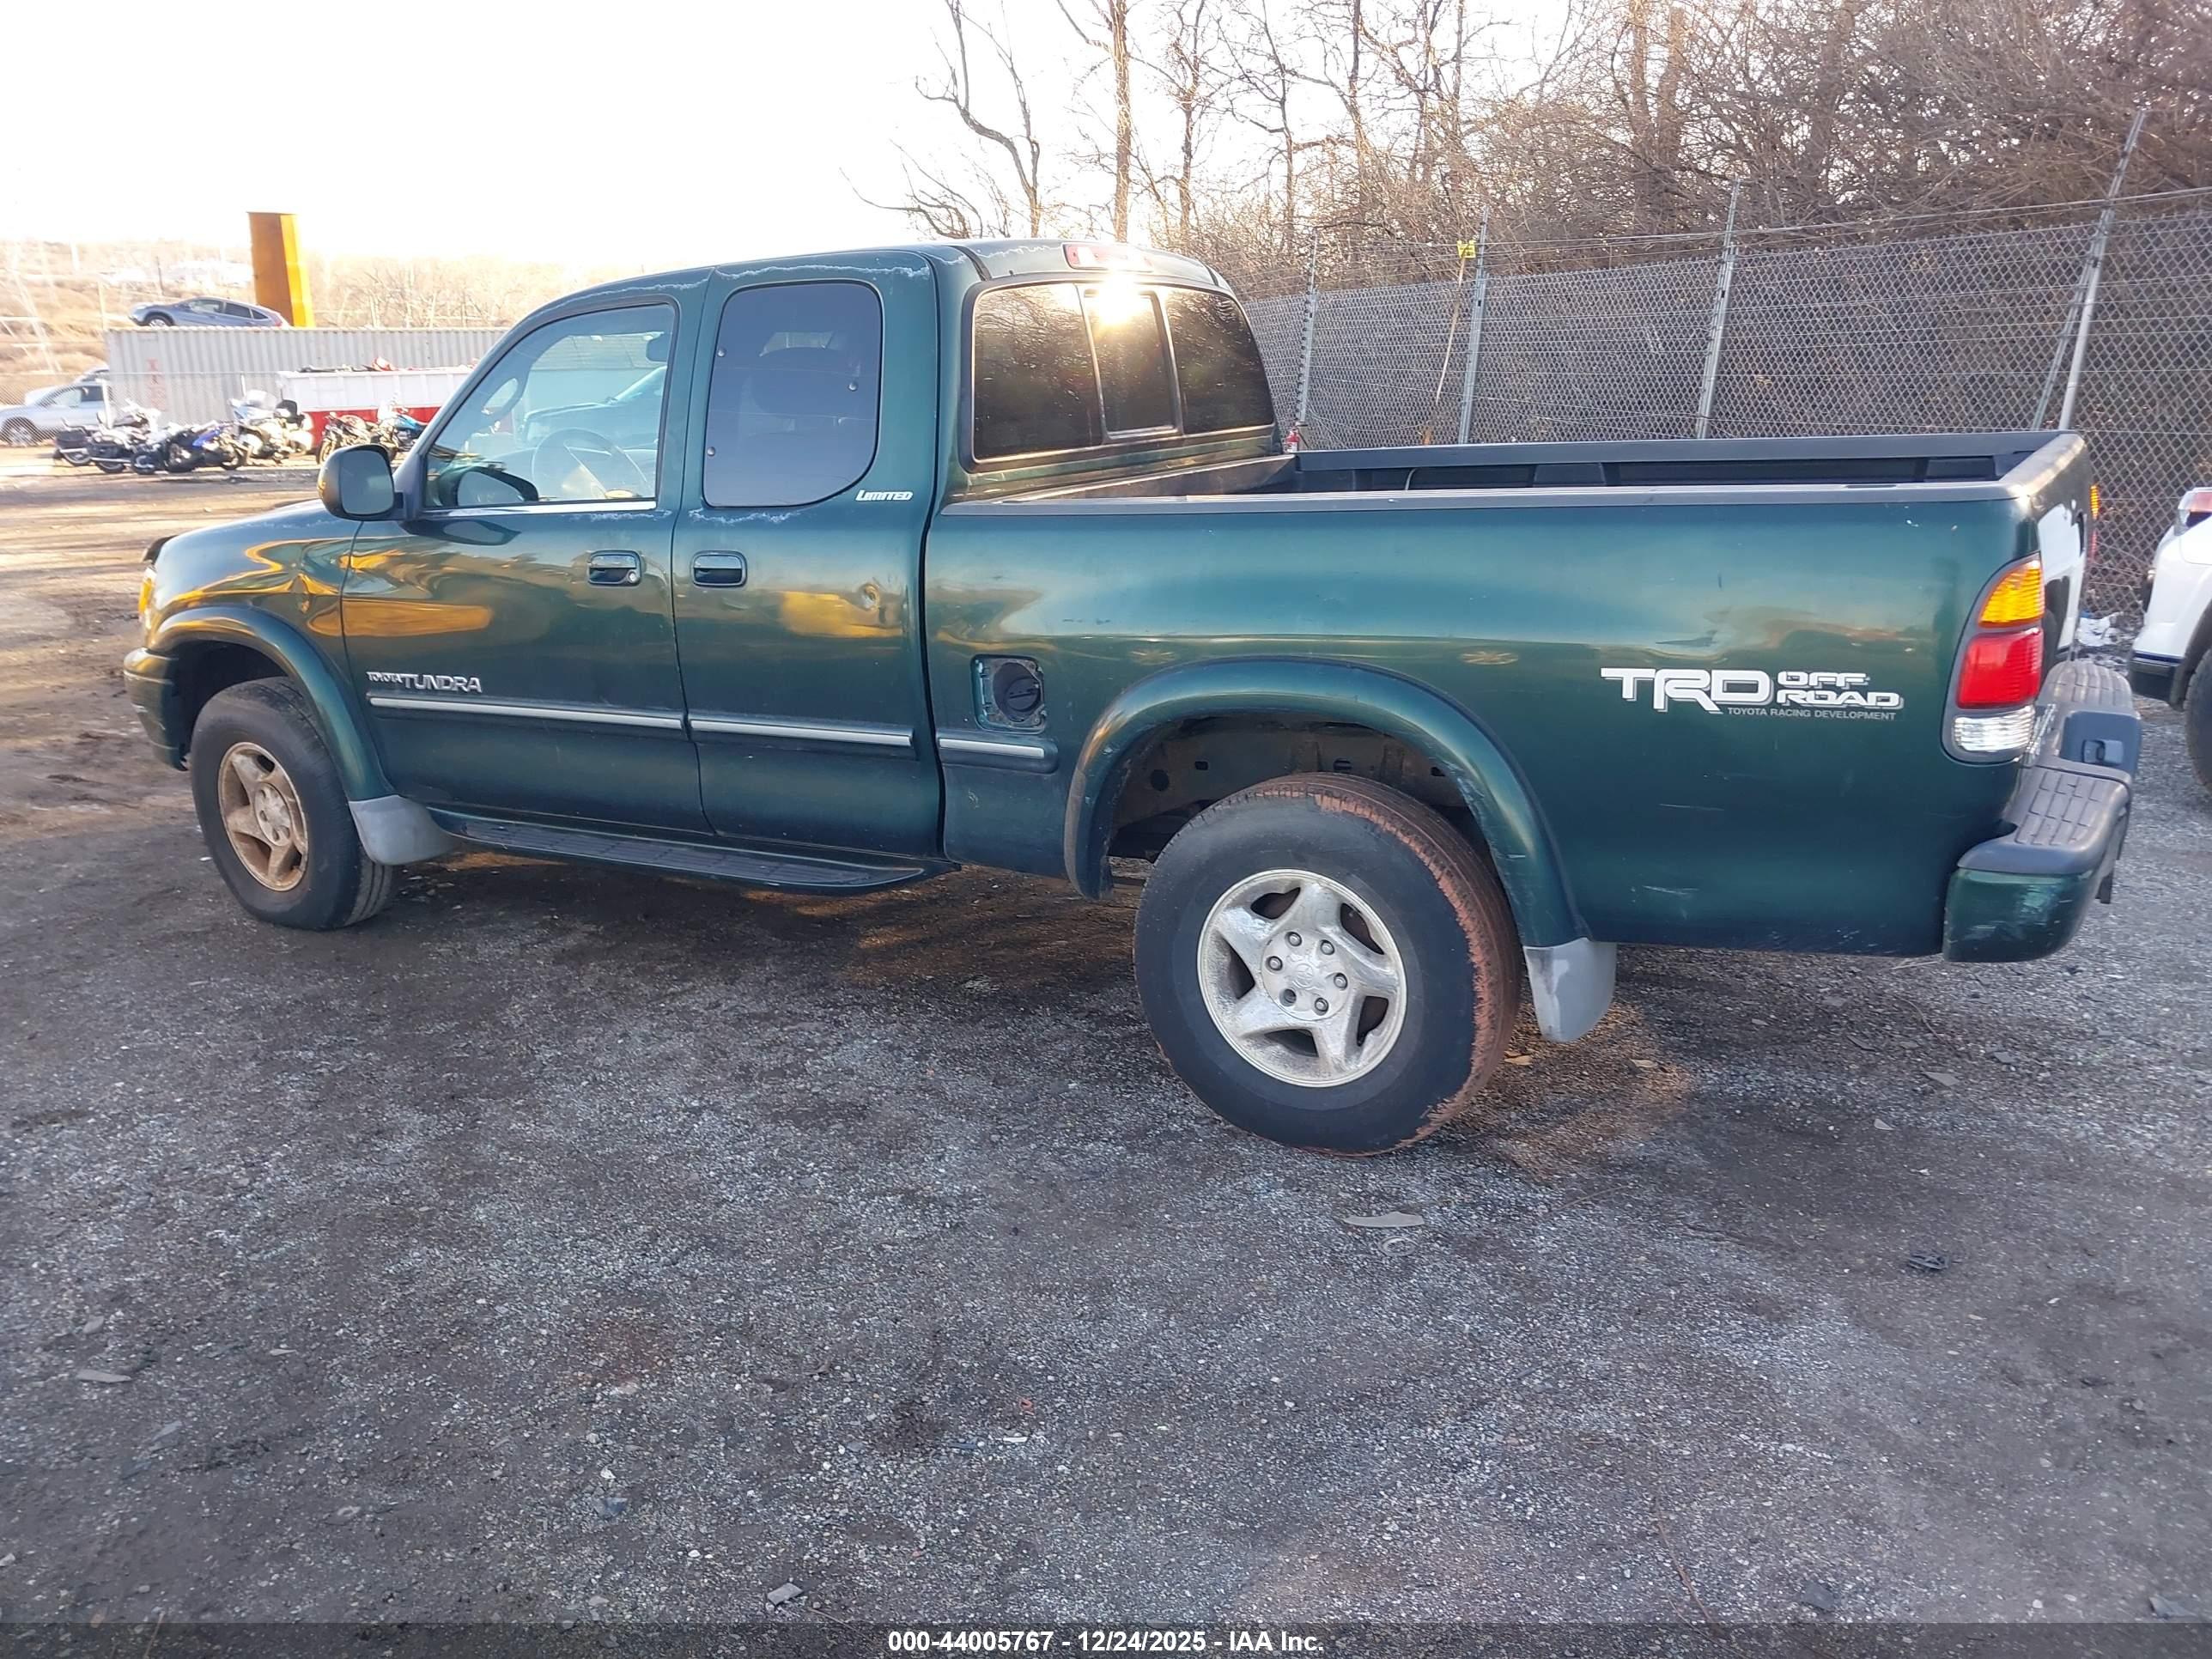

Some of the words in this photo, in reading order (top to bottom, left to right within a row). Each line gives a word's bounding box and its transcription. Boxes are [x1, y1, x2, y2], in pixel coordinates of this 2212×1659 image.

[400, 673, 483, 693] TUNDRA
[1778, 671, 1870, 688] OFF
[1601, 667, 1774, 714] TRD
[1777, 690, 1904, 710] ROAD
[1728, 707, 1767, 716] TOYOTA
[1770, 708, 1811, 718] RACING
[1814, 710, 1896, 720] DEVELOPMENT
